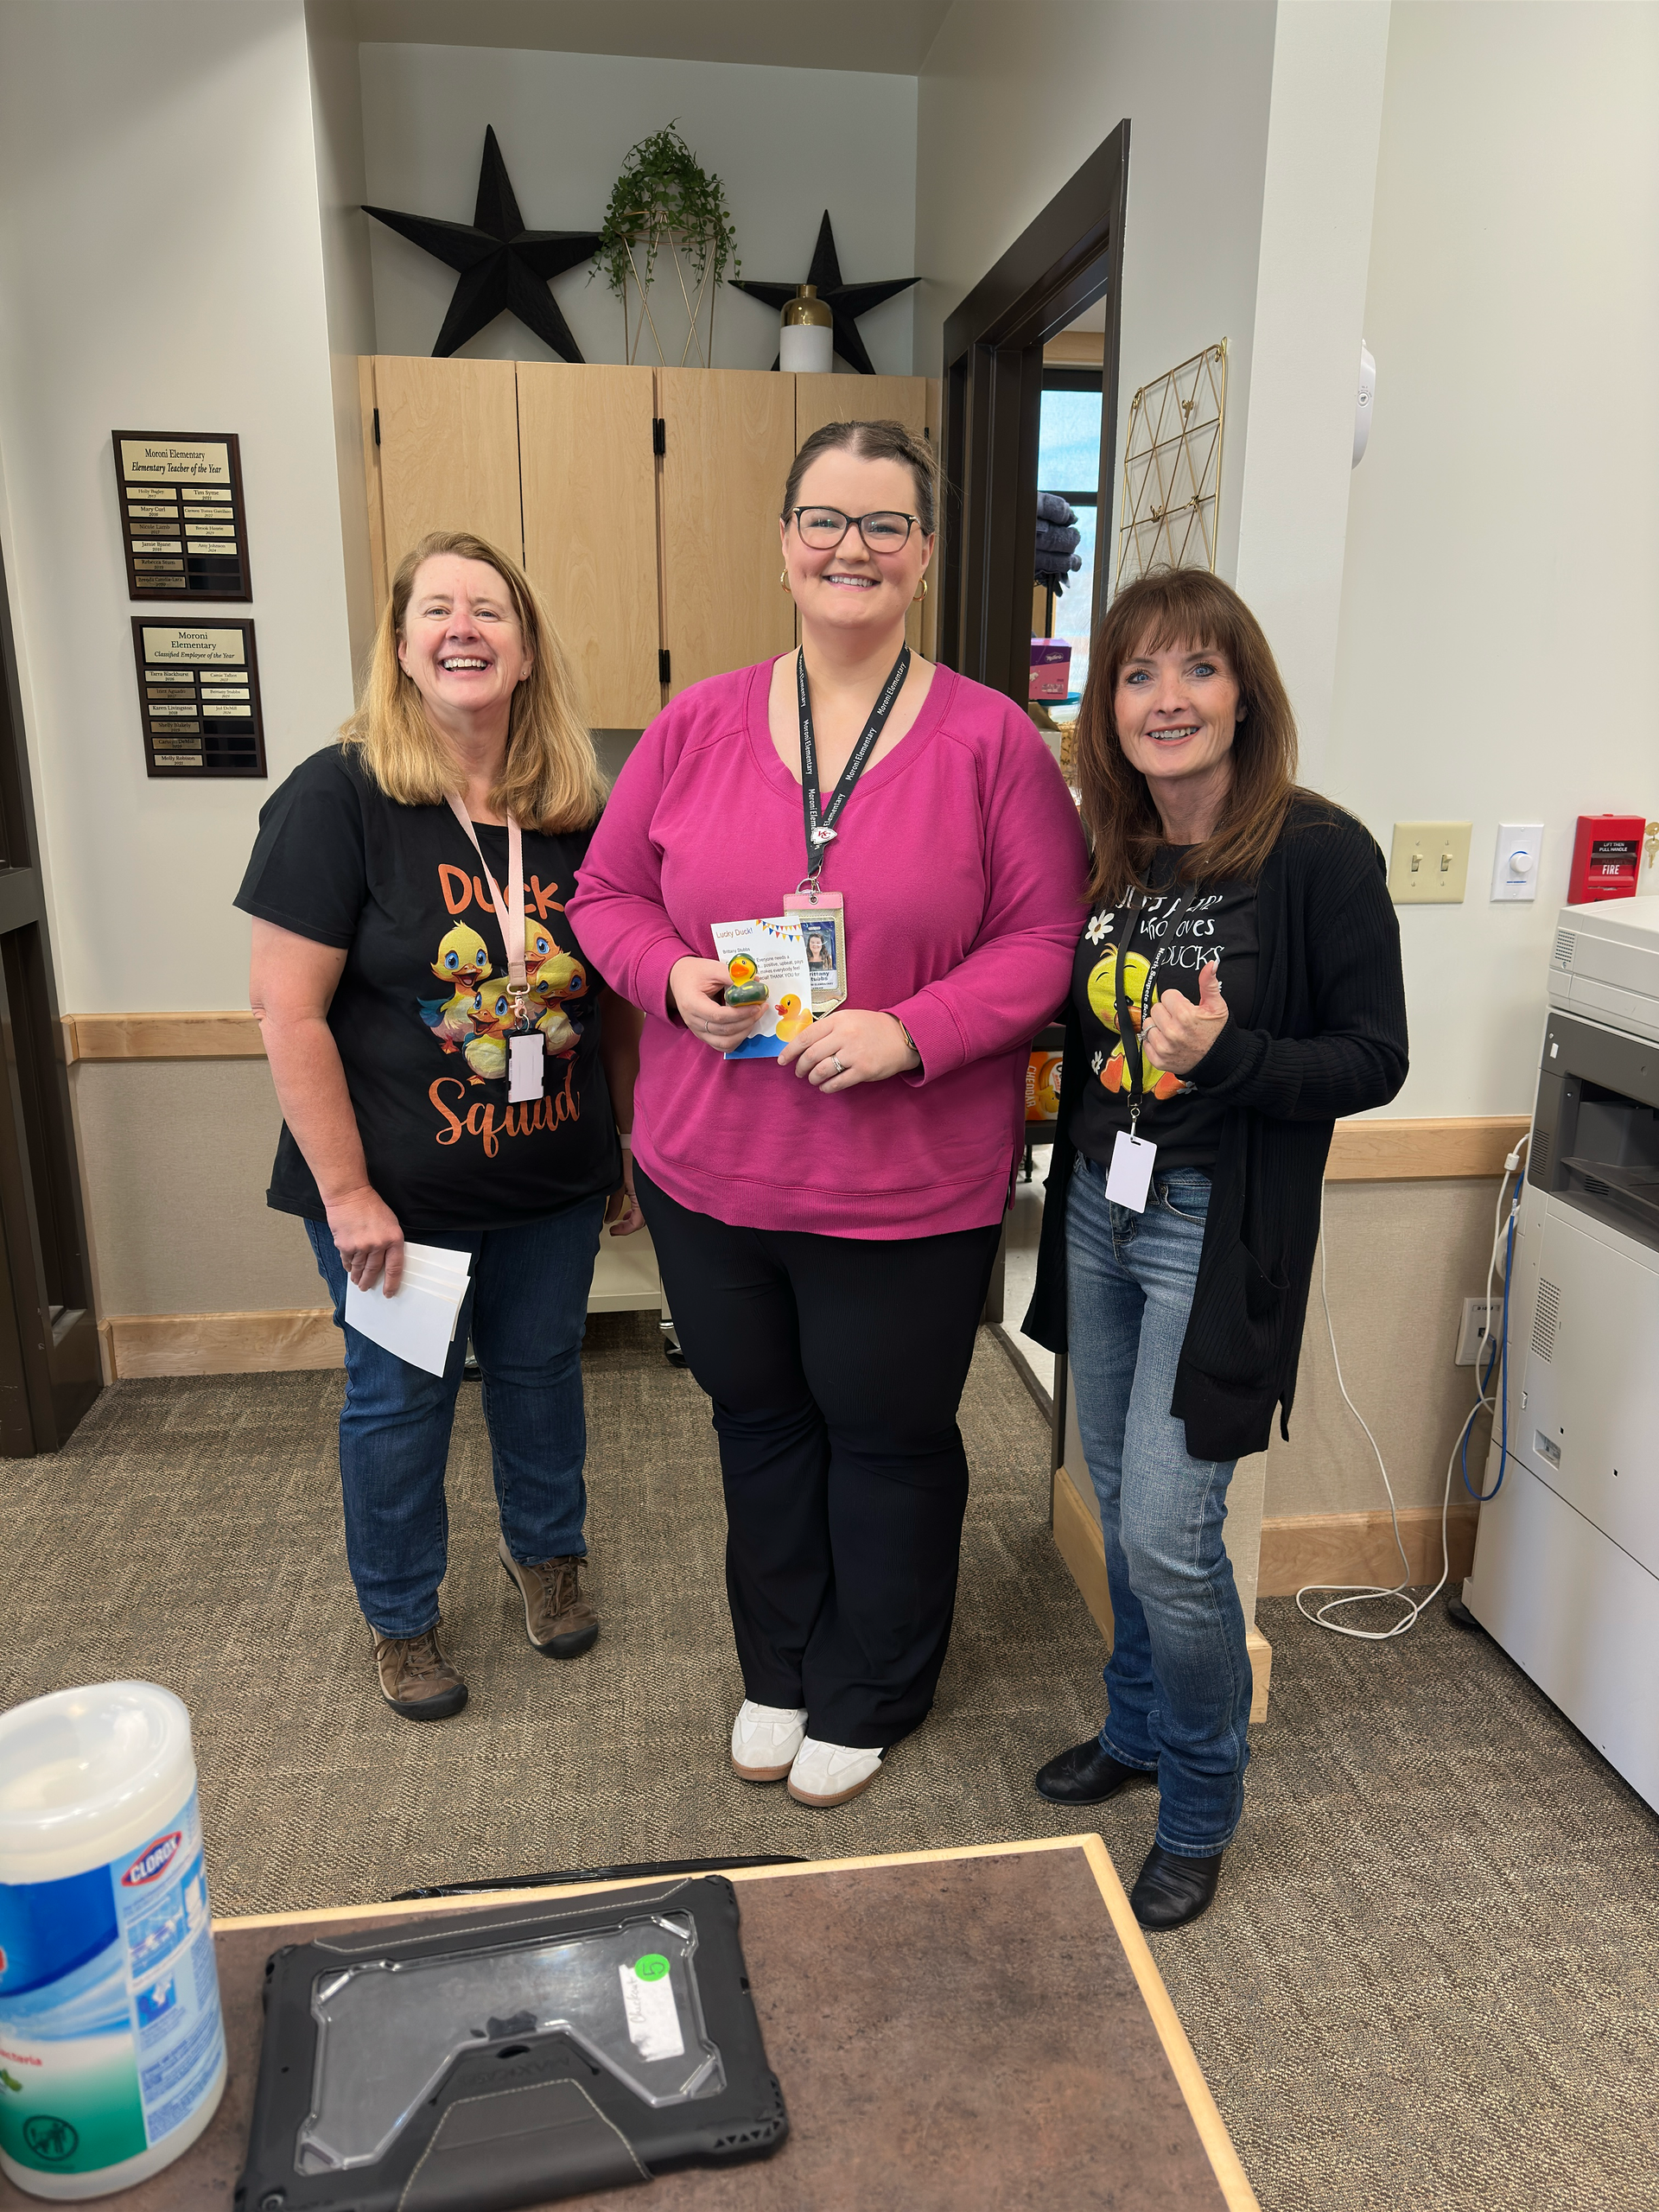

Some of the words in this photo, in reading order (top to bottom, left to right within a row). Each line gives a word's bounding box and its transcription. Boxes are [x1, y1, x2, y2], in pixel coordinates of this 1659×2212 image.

[145, 448, 168, 459] Moroni
[169, 449, 205, 461] Elementary
[131, 461, 165, 474] Elementary
[167, 463, 189, 473] Teacher
[190, 463, 198, 475] of
[198, 464, 207, 473] the
[208, 464, 221, 474] Year
[171, 641, 216, 651] Elementary
[877, 693, 893, 715] Moroni
[887, 661, 906, 695] Elementary
[845, 760, 860, 781] Moroni
[855, 727, 877, 761] Elementary
[808, 788, 817, 810] Moroni
[823, 793, 846, 826] Elementary
[1602, 865, 1620, 874] FIRE
[734, 927, 753, 936] Duck!
[1176, 919, 1215, 937] oves
[1153, 947, 1166, 968] North
[1144, 968, 1156, 1001] Sanpete
[1026, 1065, 1036, 1108] CHEDDAR
[429, 1055, 581, 1158] Squad
[130, 1837, 178, 1884] CLOROX
[642, 1961, 665, 1976] 5
